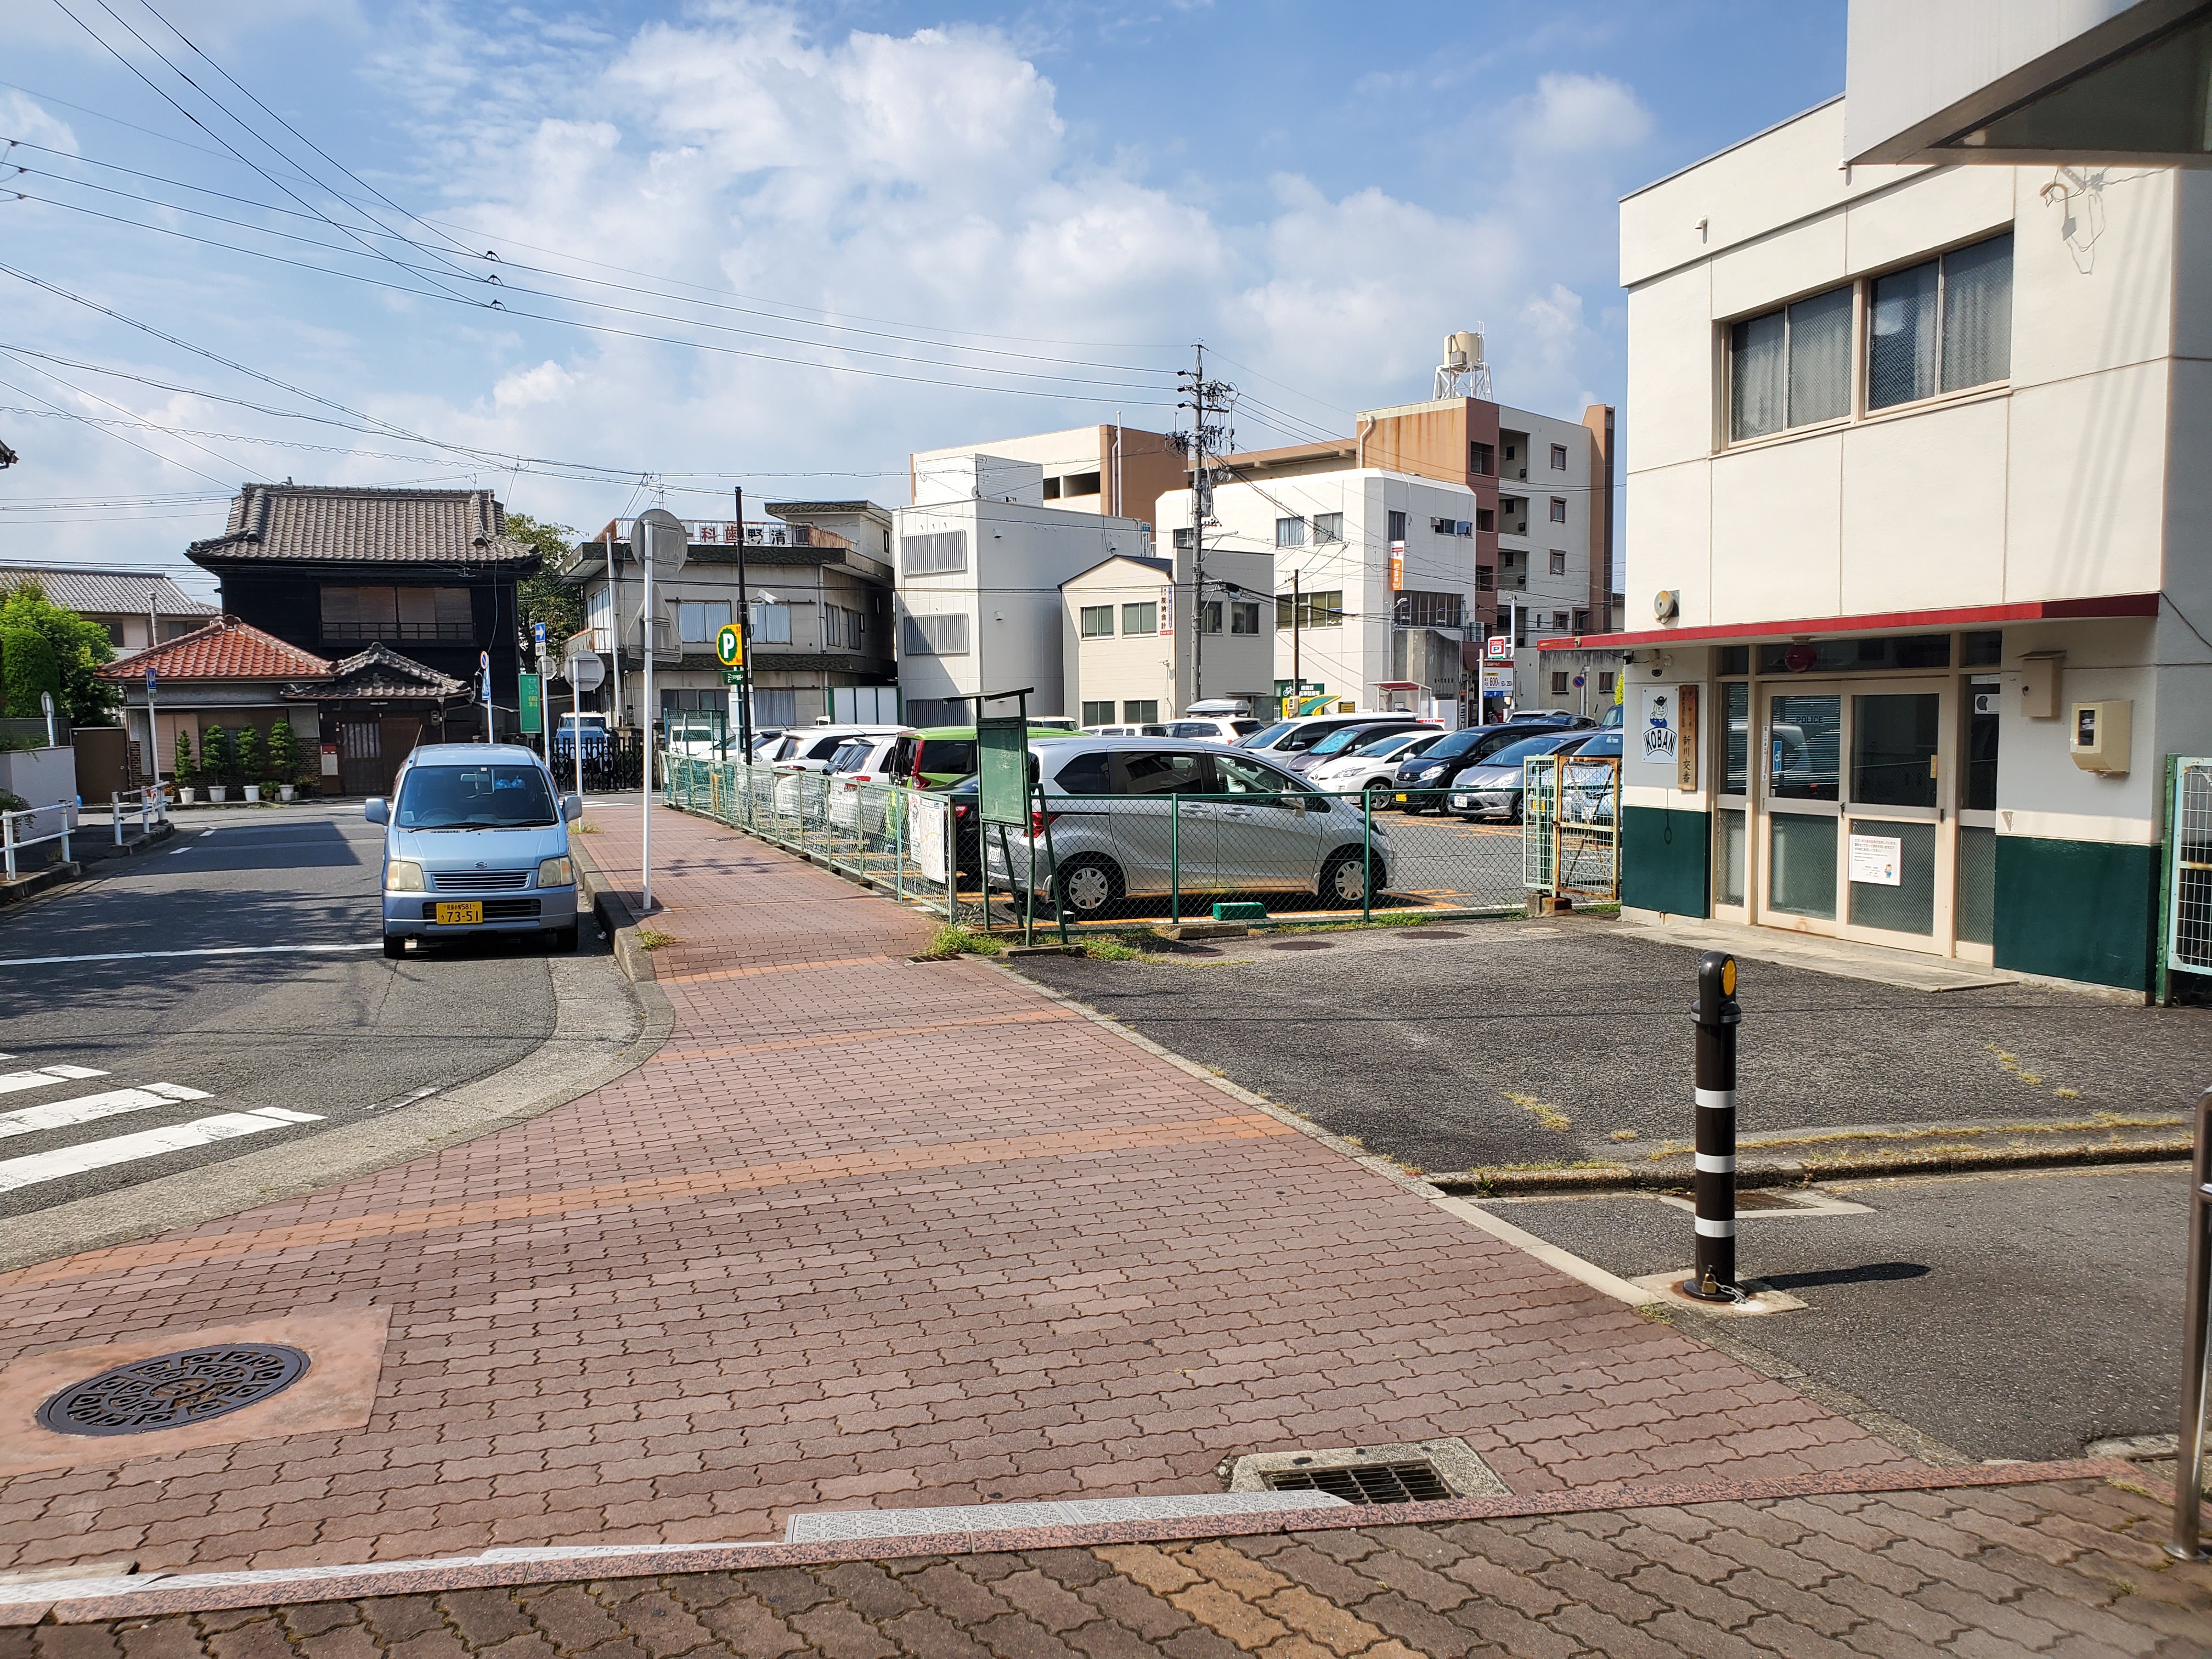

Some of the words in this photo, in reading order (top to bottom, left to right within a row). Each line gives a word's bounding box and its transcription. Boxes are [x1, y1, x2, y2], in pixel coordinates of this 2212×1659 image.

[723, 633, 735, 659] P
[528, 678, 538, 708] せいの歯科
[1645, 729, 1675, 753] KOBAN
[1683, 735, 1691, 783] 新川交番
[447, 910, 478, 923] 73-51
